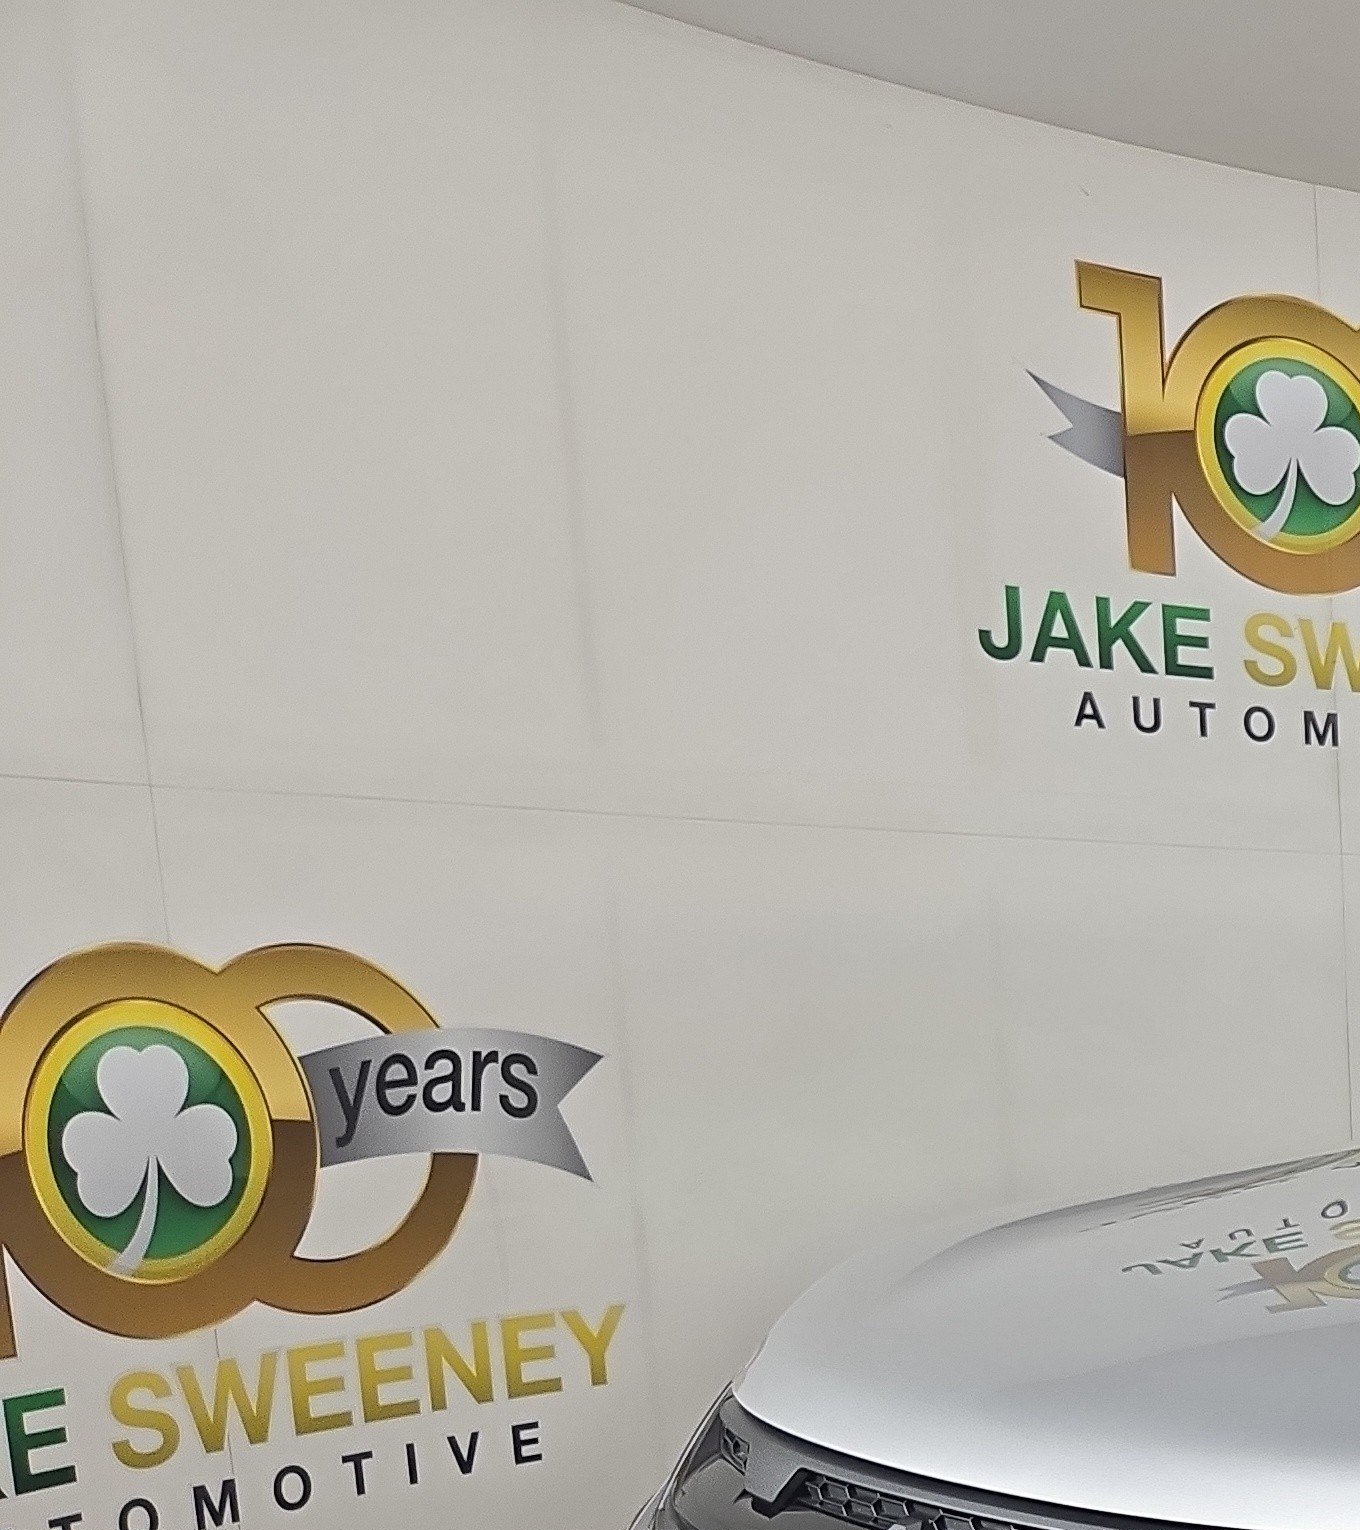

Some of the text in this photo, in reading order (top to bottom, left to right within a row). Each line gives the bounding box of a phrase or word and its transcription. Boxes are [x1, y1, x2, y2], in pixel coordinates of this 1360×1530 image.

[978, 585, 1215, 680] JAKE
[327, 1047, 540, 1148] years
[108, 1304, 626, 1470] SWEENEY
